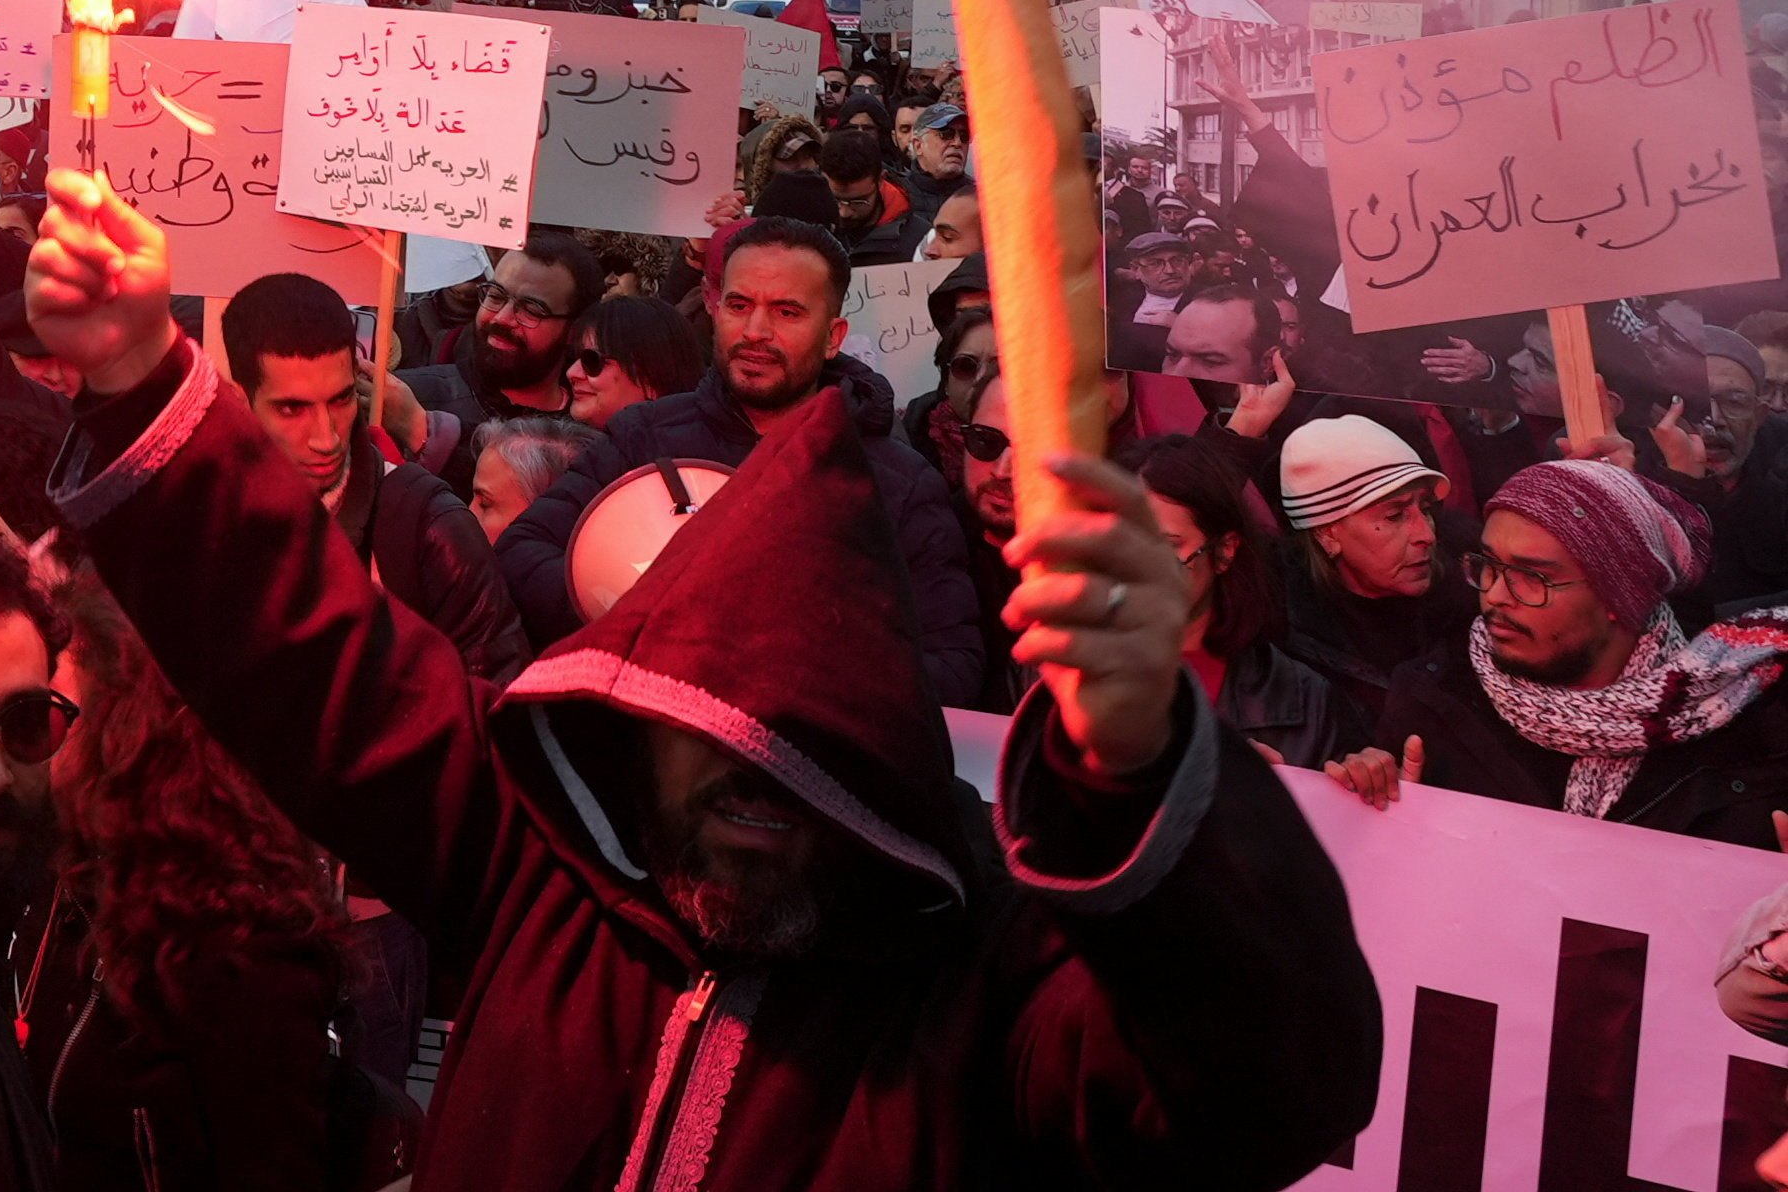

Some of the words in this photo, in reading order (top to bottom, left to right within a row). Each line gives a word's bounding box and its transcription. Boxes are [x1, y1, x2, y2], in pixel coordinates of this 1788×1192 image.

[573, 59, 693, 105] خبز
[1549, 7, 1724, 141] الظلم
[1344, 154, 1525, 292] العمران
